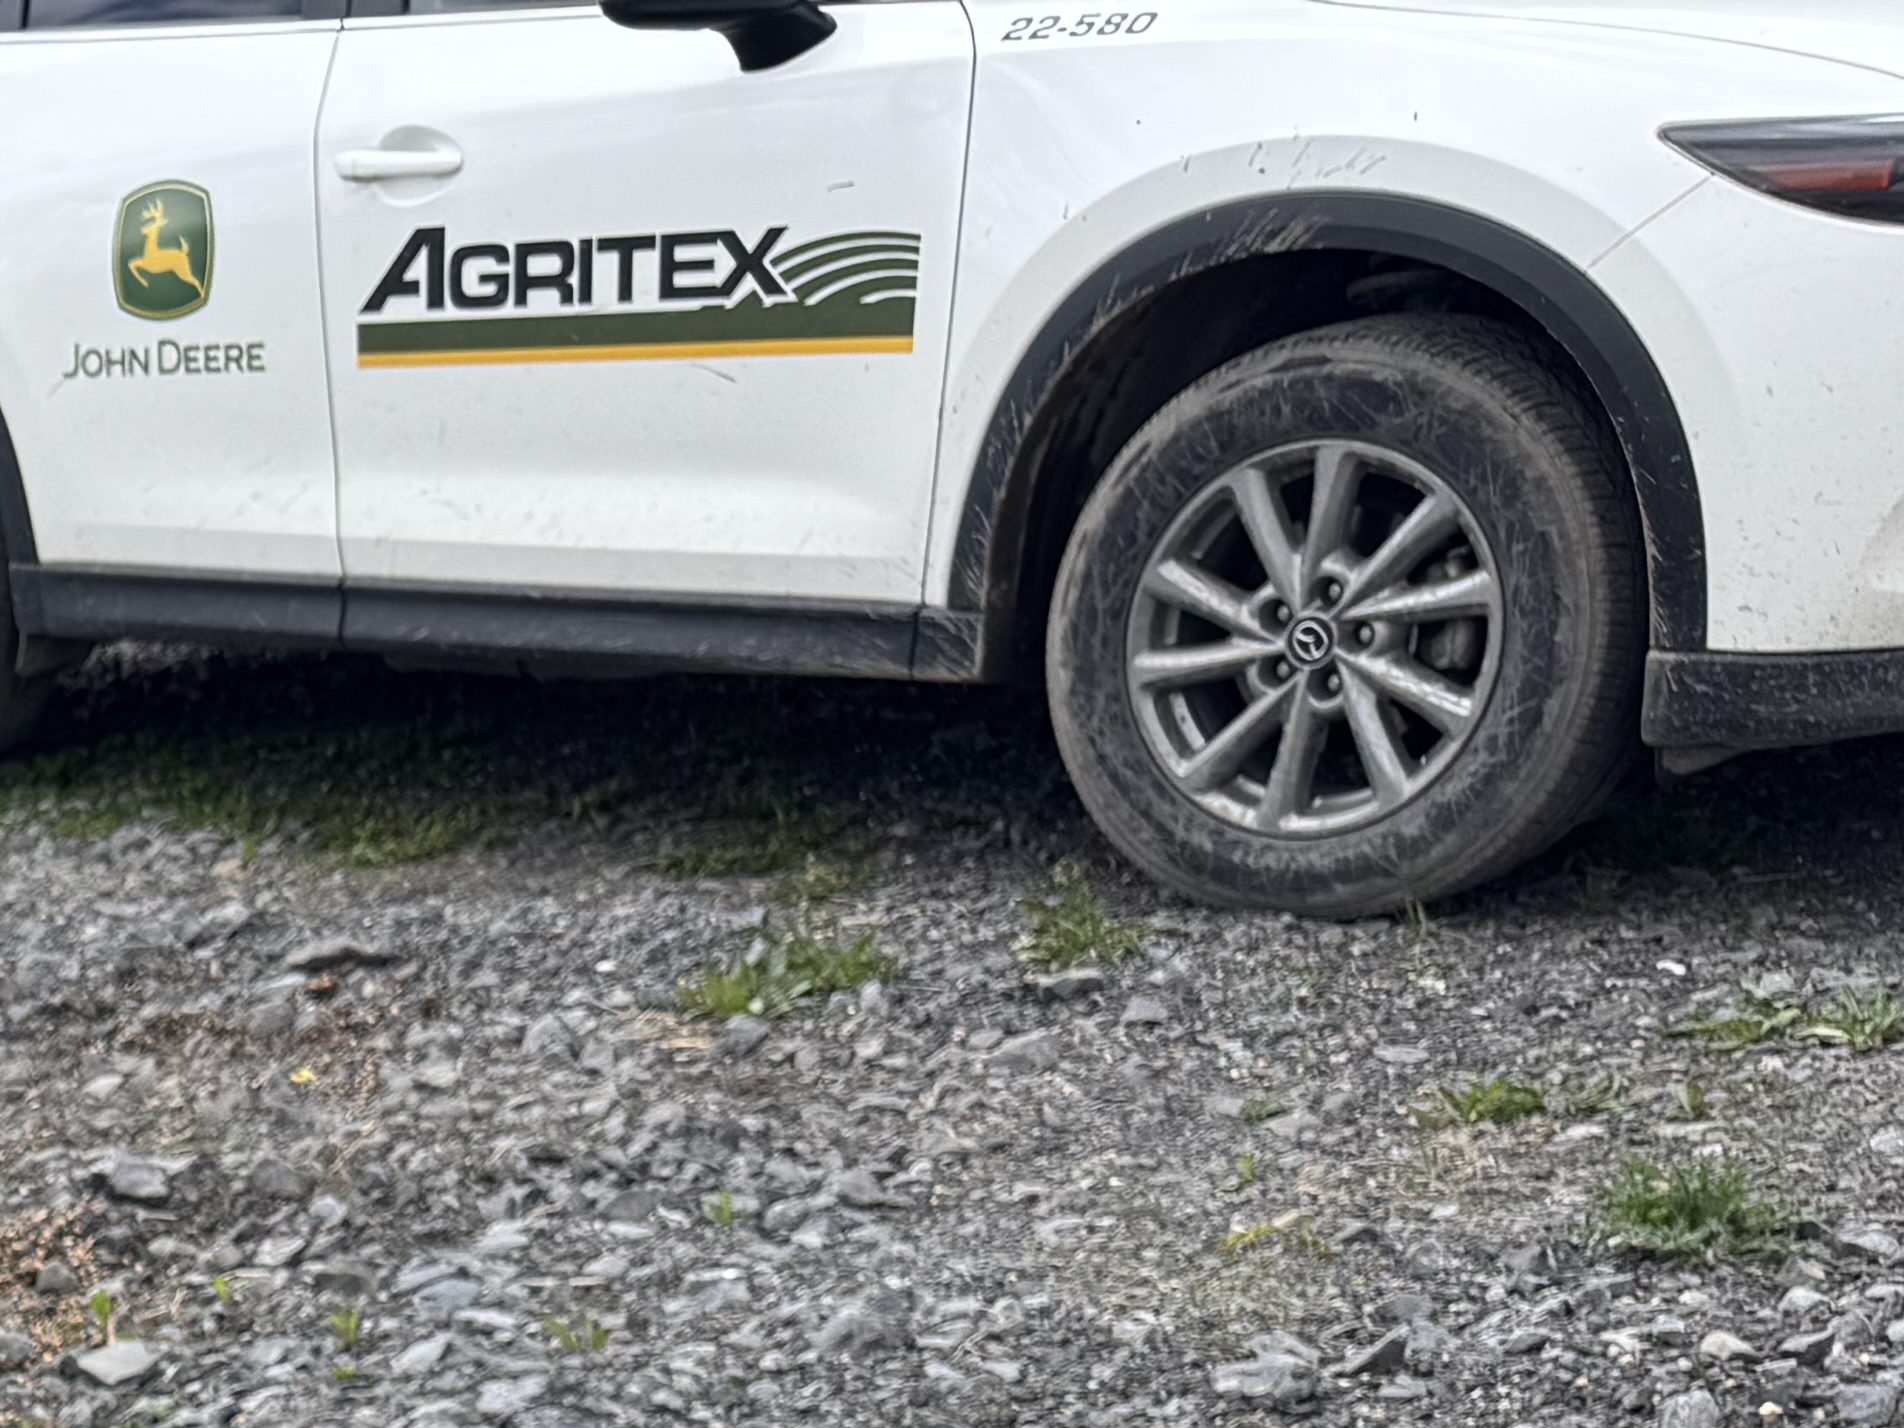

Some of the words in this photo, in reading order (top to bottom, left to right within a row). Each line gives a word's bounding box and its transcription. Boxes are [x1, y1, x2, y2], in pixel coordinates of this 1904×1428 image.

[1000, 11, 1159, 43] 22-580
[358, 224, 796, 314] AGRITEX
[62, 342, 150, 379] JOHN
[157, 338, 267, 376] DEERE
